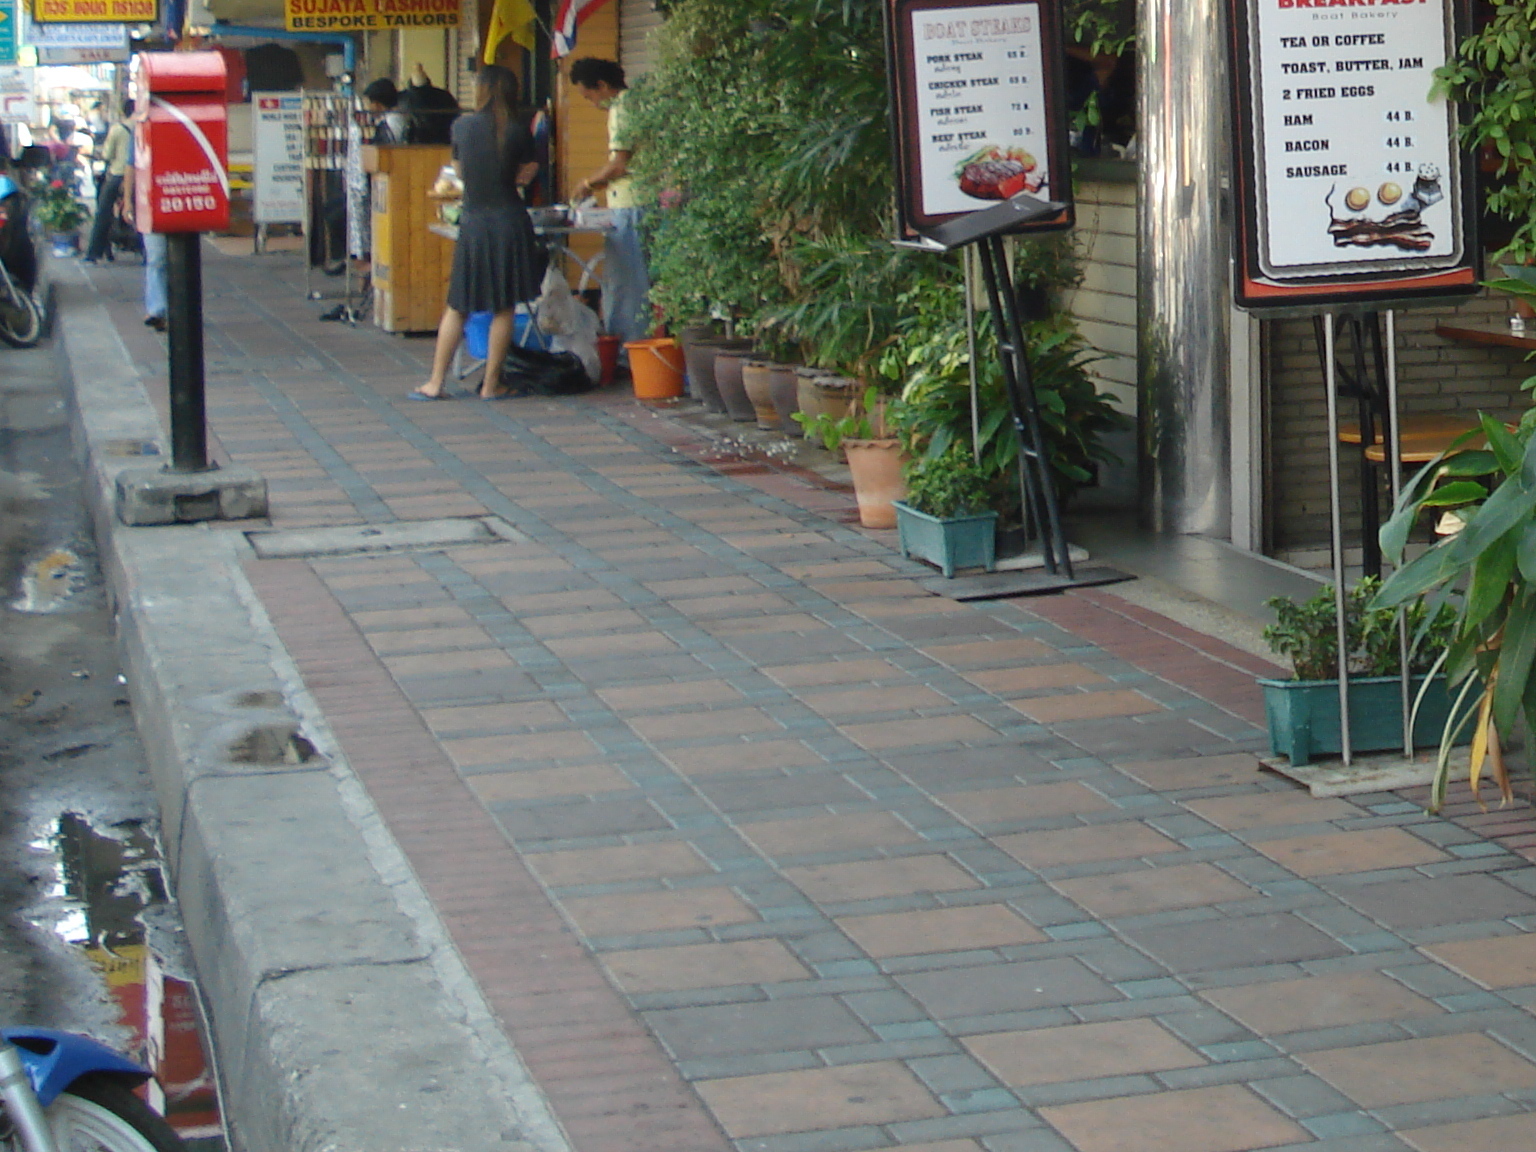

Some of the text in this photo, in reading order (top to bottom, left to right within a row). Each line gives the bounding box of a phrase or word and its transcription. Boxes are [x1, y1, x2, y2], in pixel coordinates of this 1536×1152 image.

[292, 13, 458, 28] BESPOKE TAILORS
[1351, 11, 1399, 20] Bakery
[923, 17, 1031, 40] BOAT STEAKS
[1280, 34, 1385, 48] TEA OR COFFEE
[926, 52, 983, 64] PORK STEAK
[1281, 57, 1423, 74] TOAST, BUTTER, JAM
[928, 77, 999, 90] CHICKEN STEAK
[1282, 86, 1375, 100] 2 FRIED EGGS
[930, 105, 983, 116] FISH STEAK
[1386, 111, 1414, 121] 44 B.
[1284, 114, 1313, 126] HAM
[932, 131, 987, 143] BEEF STEAK
[1386, 137, 1414, 147] 44 B.
[1285, 139, 1329, 152] BACON
[1286, 164, 1347, 178] SAUSAGE
[1386, 162, 1414, 172] 44 B.
